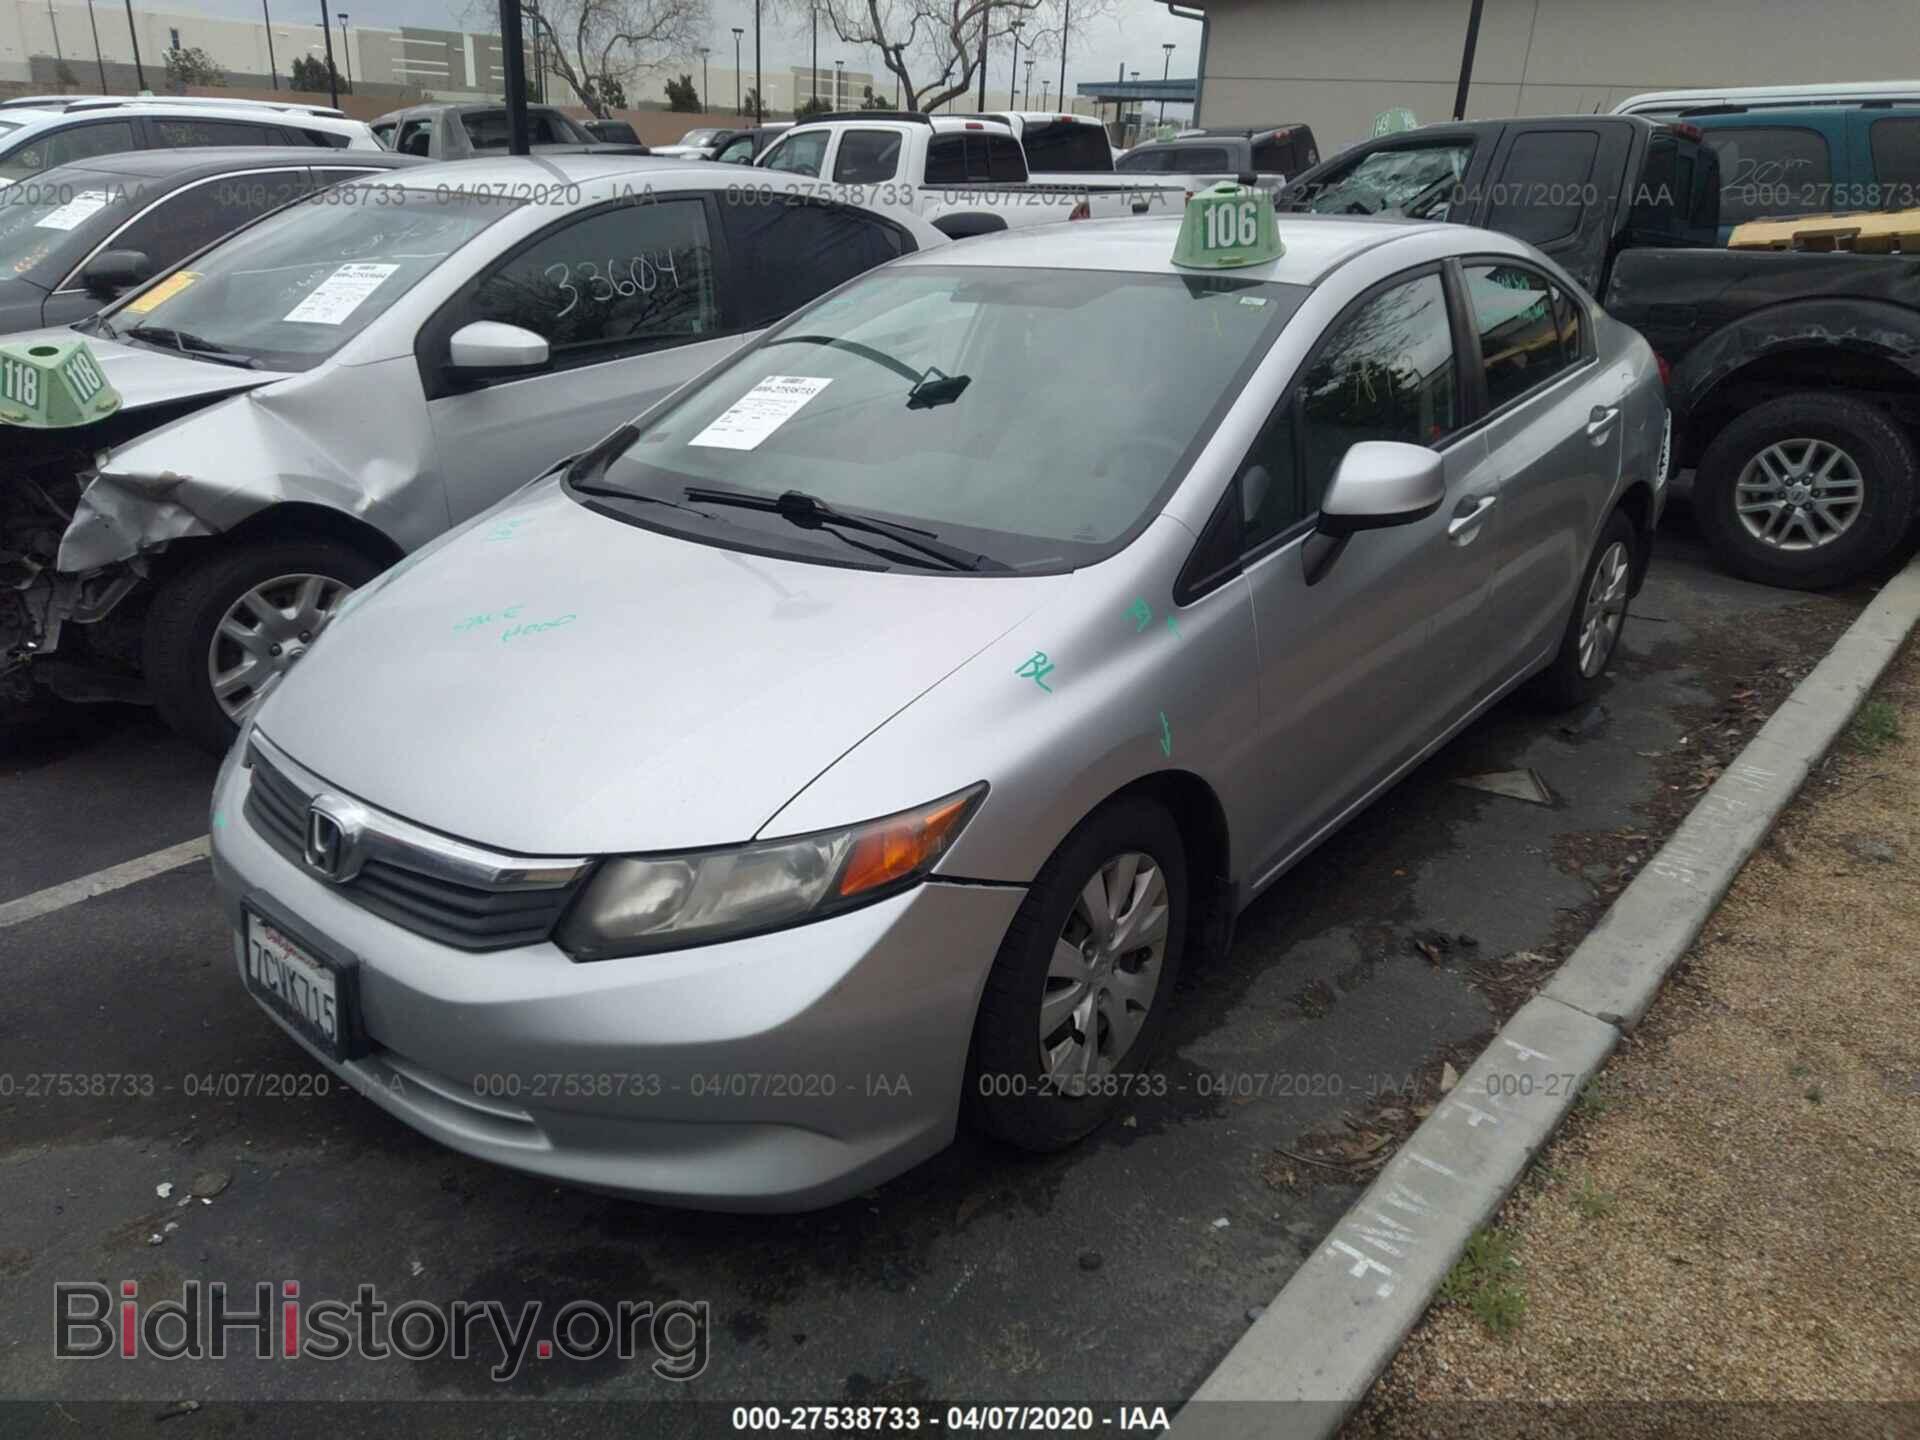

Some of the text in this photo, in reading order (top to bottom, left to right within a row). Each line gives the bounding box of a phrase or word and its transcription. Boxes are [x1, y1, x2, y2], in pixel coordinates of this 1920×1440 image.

[1204, 201, 1257, 248] 106
[544, 248, 679, 317] 33604
[5, 359, 37, 406] 118
[66, 352, 101, 400] 118
[251, 938, 335, 1040] 7CVK715
